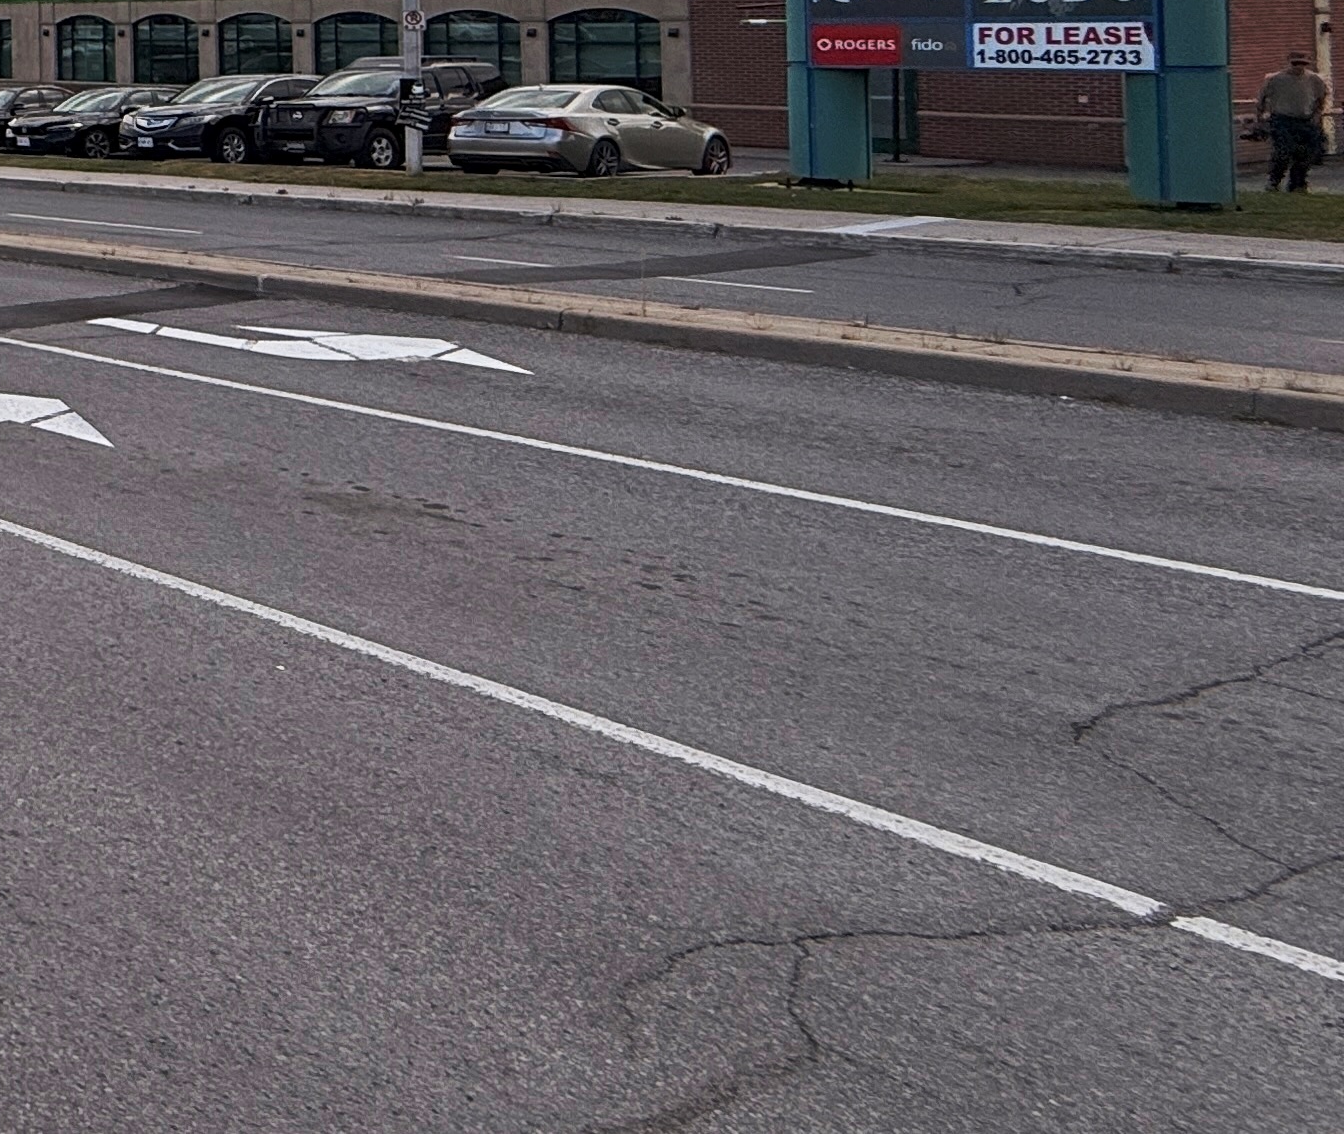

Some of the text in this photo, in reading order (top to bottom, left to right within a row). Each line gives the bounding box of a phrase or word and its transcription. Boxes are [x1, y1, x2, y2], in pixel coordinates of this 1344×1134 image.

[978, 27, 1142, 45] FOR LEASE
[835, 38, 944, 51] ROGERS fido
[976, 49, 1142, 65] 1-800-465-2733
